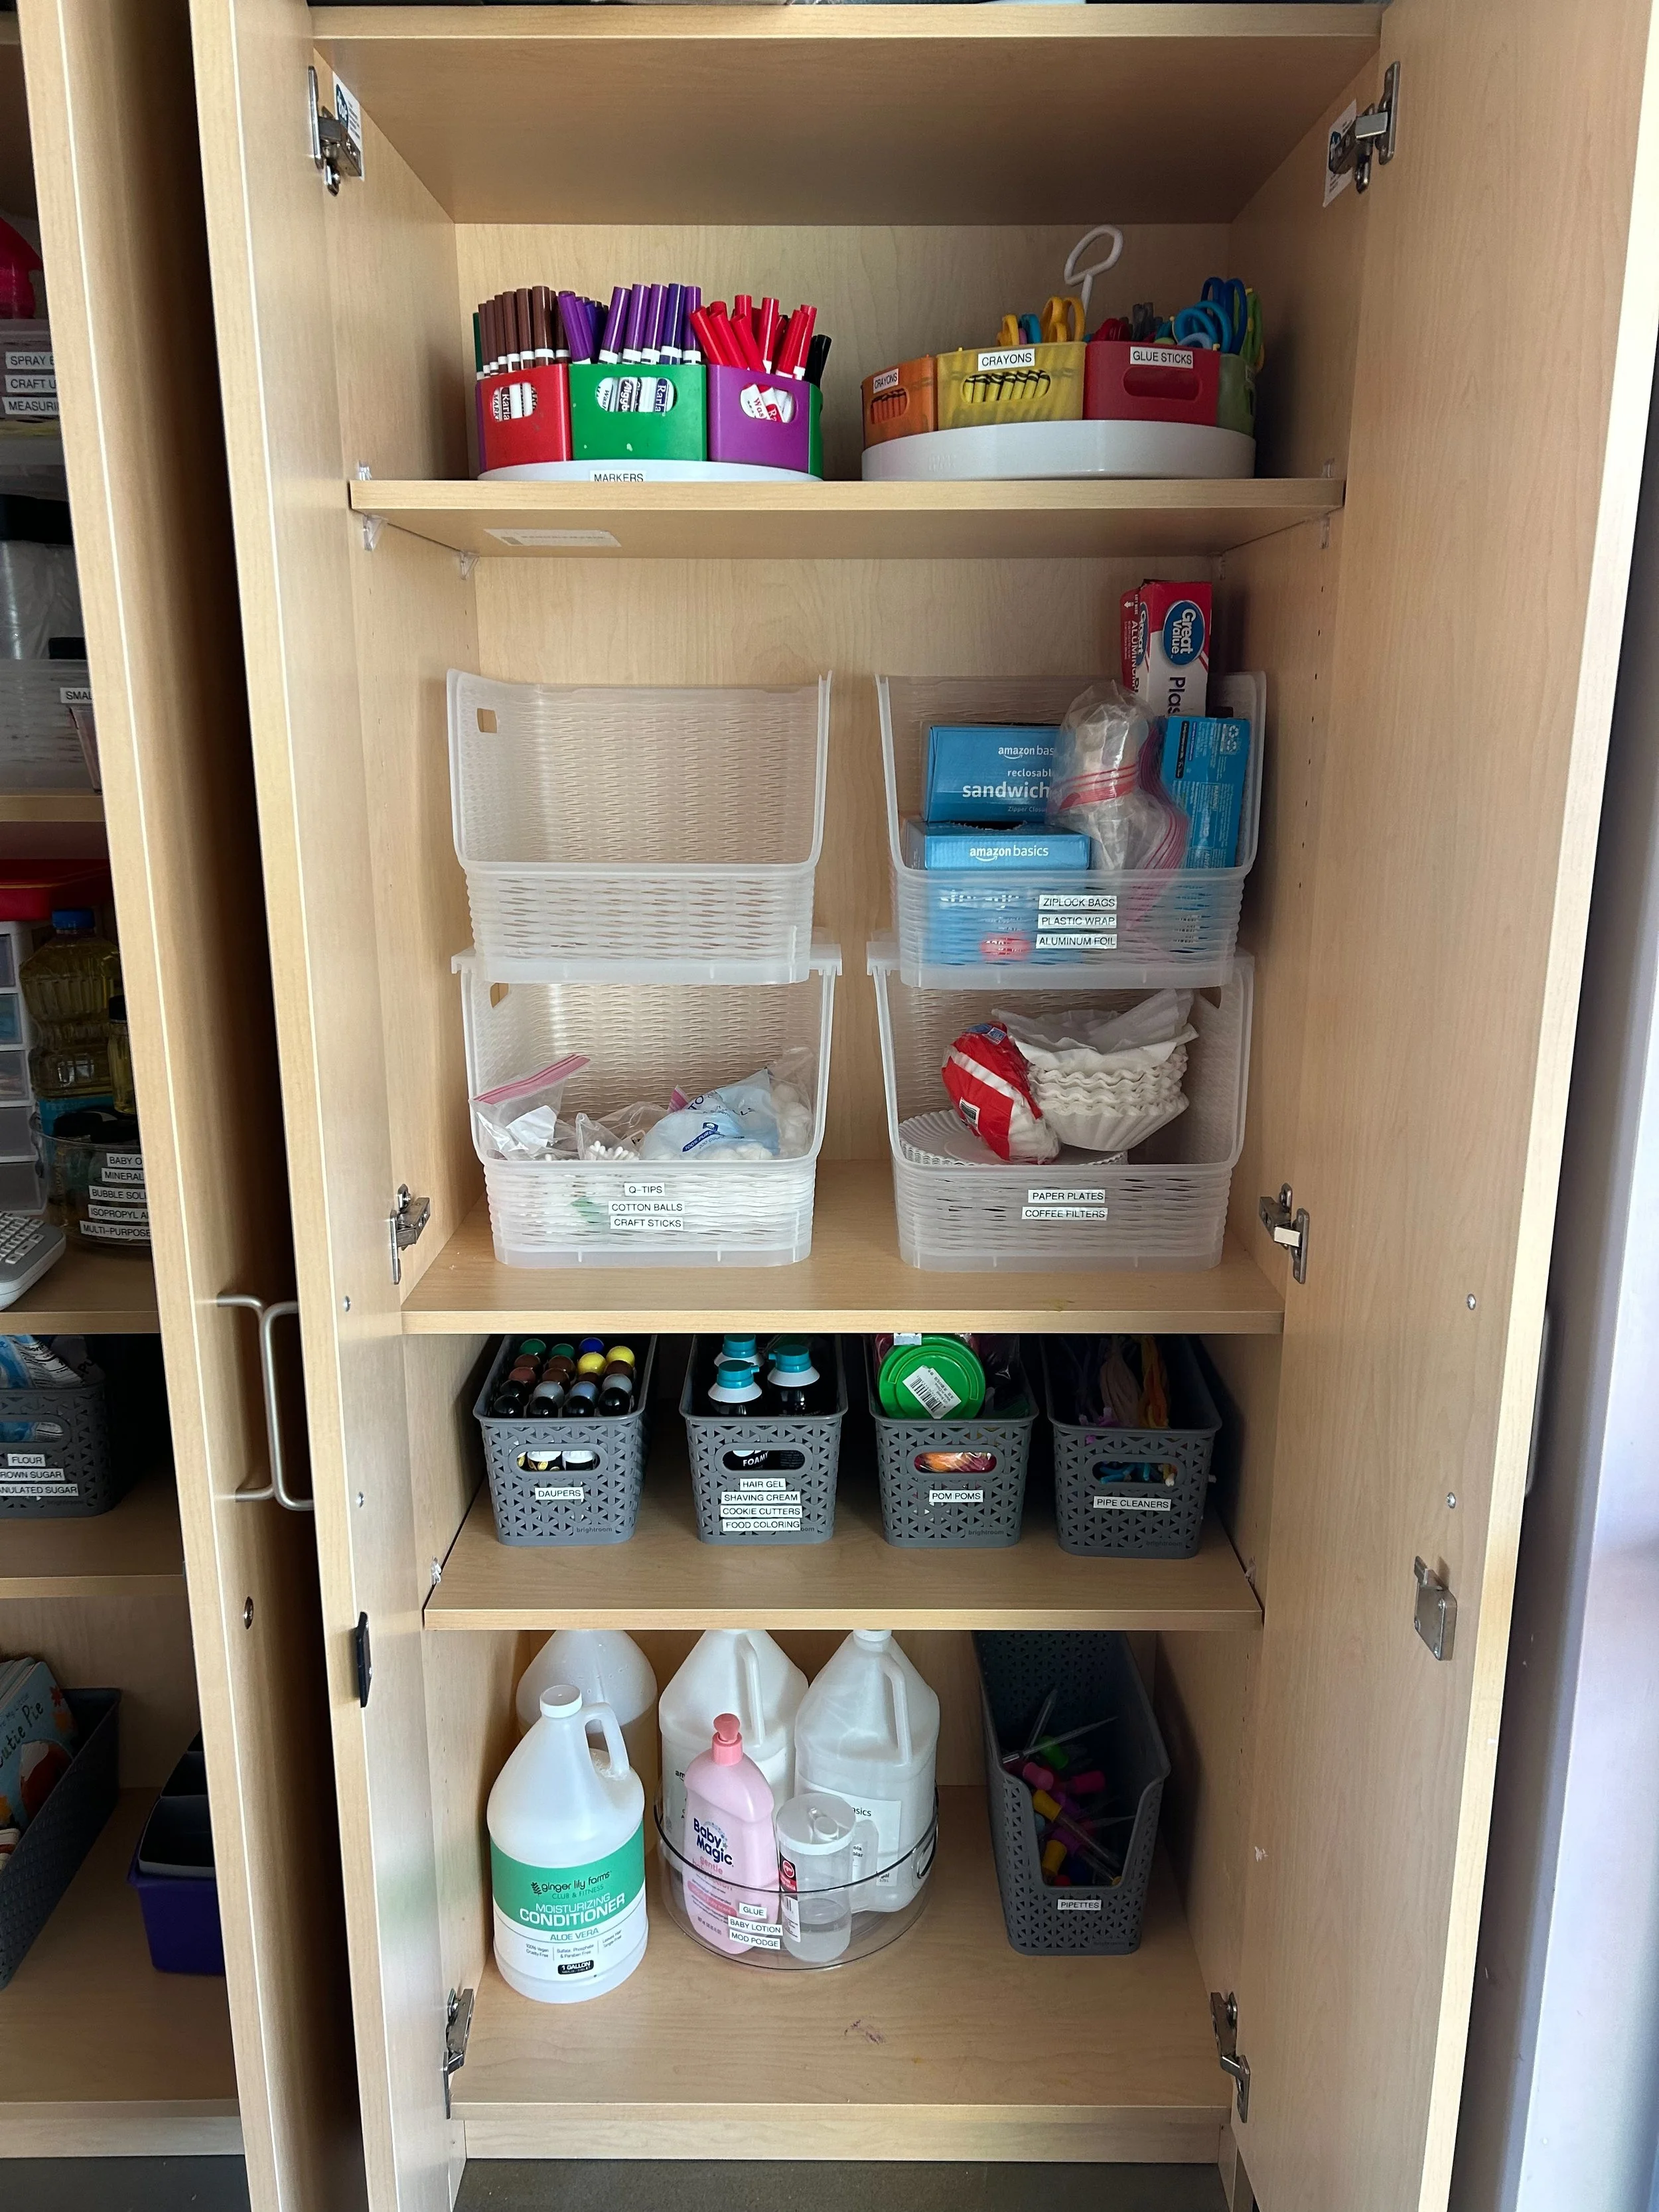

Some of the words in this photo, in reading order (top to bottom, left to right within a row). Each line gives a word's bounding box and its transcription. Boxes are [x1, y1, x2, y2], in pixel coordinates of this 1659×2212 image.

[11, 356, 45, 366] SPRAY
[982, 352, 1032, 366] CRAYONS
[1133, 351, 1159, 362] GLUE
[1161, 353, 1192, 364] STICKS
[11, 379, 45, 389] CRAFT
[874, 373, 897, 389] CRAYONS
[594, 473, 644, 482] MARKERS
[1172, 620, 1182, 654] Value
[1181, 609, 1196, 654] Great
[998, 746, 1035, 757] amazon
[963, 781, 1050, 798] sandwich
[970, 847, 1011, 859] amazon
[1013, 845, 1048, 856] basics
[1043, 898, 1086, 907] ZIPLOCK
[1088, 899, 1116, 907] BAGS
[1039, 937, 1092, 946] ALUMINUM
[104, 1171, 144, 1181] MINERAL
[92, 1189, 123, 1199] BUBBLE
[91, 1208, 138, 1219] ISOPROPYL
[84, 1224, 151, 1237] MULTI-PURPOSE
[743, 1451, 768, 1467] FOAMY
[1120, 1500, 1169, 1509] CLEANERS
[693, 1818, 721, 1848] Baby
[697, 1835, 733, 1866] Magic
[700, 1856, 723, 1875] gentle
[541, 1882, 571, 1893] ginger
[574, 1880, 586, 1890] lily
[588, 1871, 610, 1885] farms
[579, 1883, 604, 1897] FITNESS
[520, 1892, 625, 1927] CONDITIONER
[536, 1893, 611, 1913] MOISTURIZING
[743, 1906, 764, 1916] GLUE
[730, 1919, 749, 1929] BABY
[751, 1923, 780, 1933] LOTION
[575, 1928, 599, 1939] VERA
[731, 1932, 749, 1942] MOD
[751, 1937, 778, 1947] PODGE
[567, 1961, 591, 1970] GALLON
